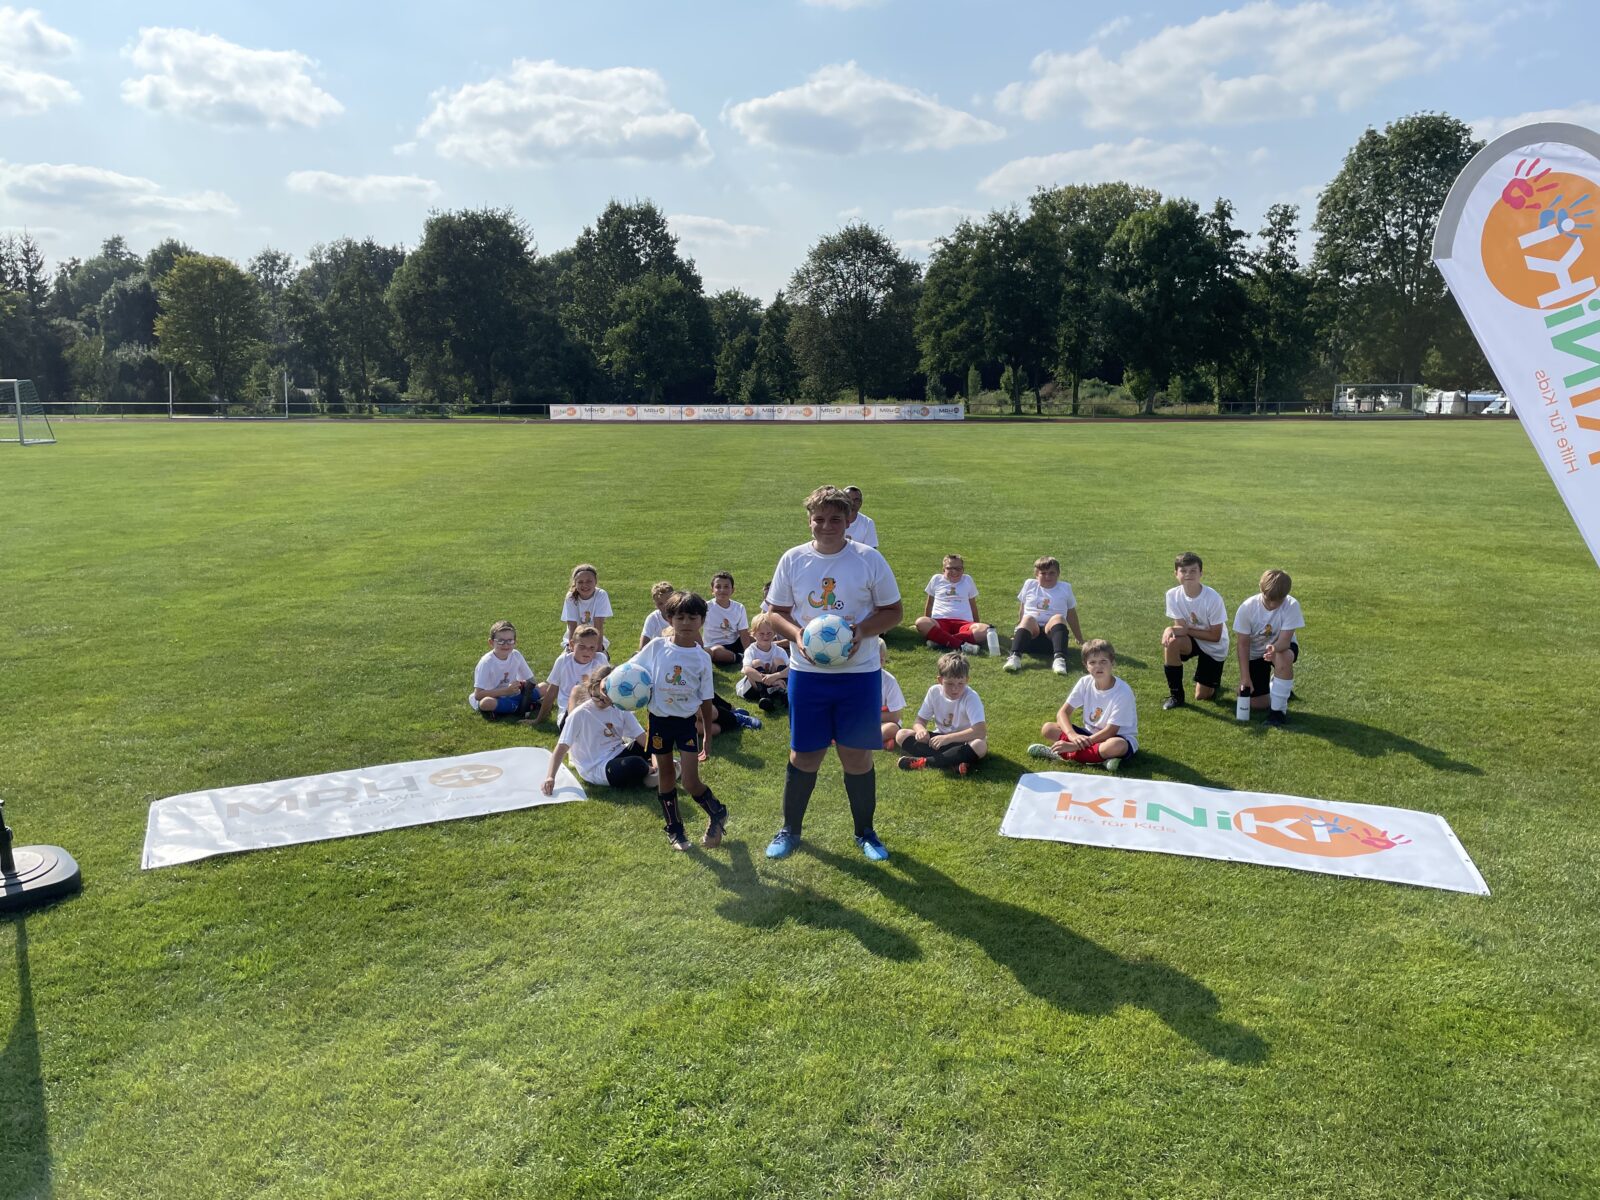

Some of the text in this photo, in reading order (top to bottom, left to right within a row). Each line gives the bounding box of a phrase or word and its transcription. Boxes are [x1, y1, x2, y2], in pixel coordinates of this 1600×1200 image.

[227, 775, 420, 818] MRH
[1055, 791, 1332, 843] KiNiKi
[1053, 813, 1095, 825] Hilfe
[1134, 821, 1177, 834] Kids
